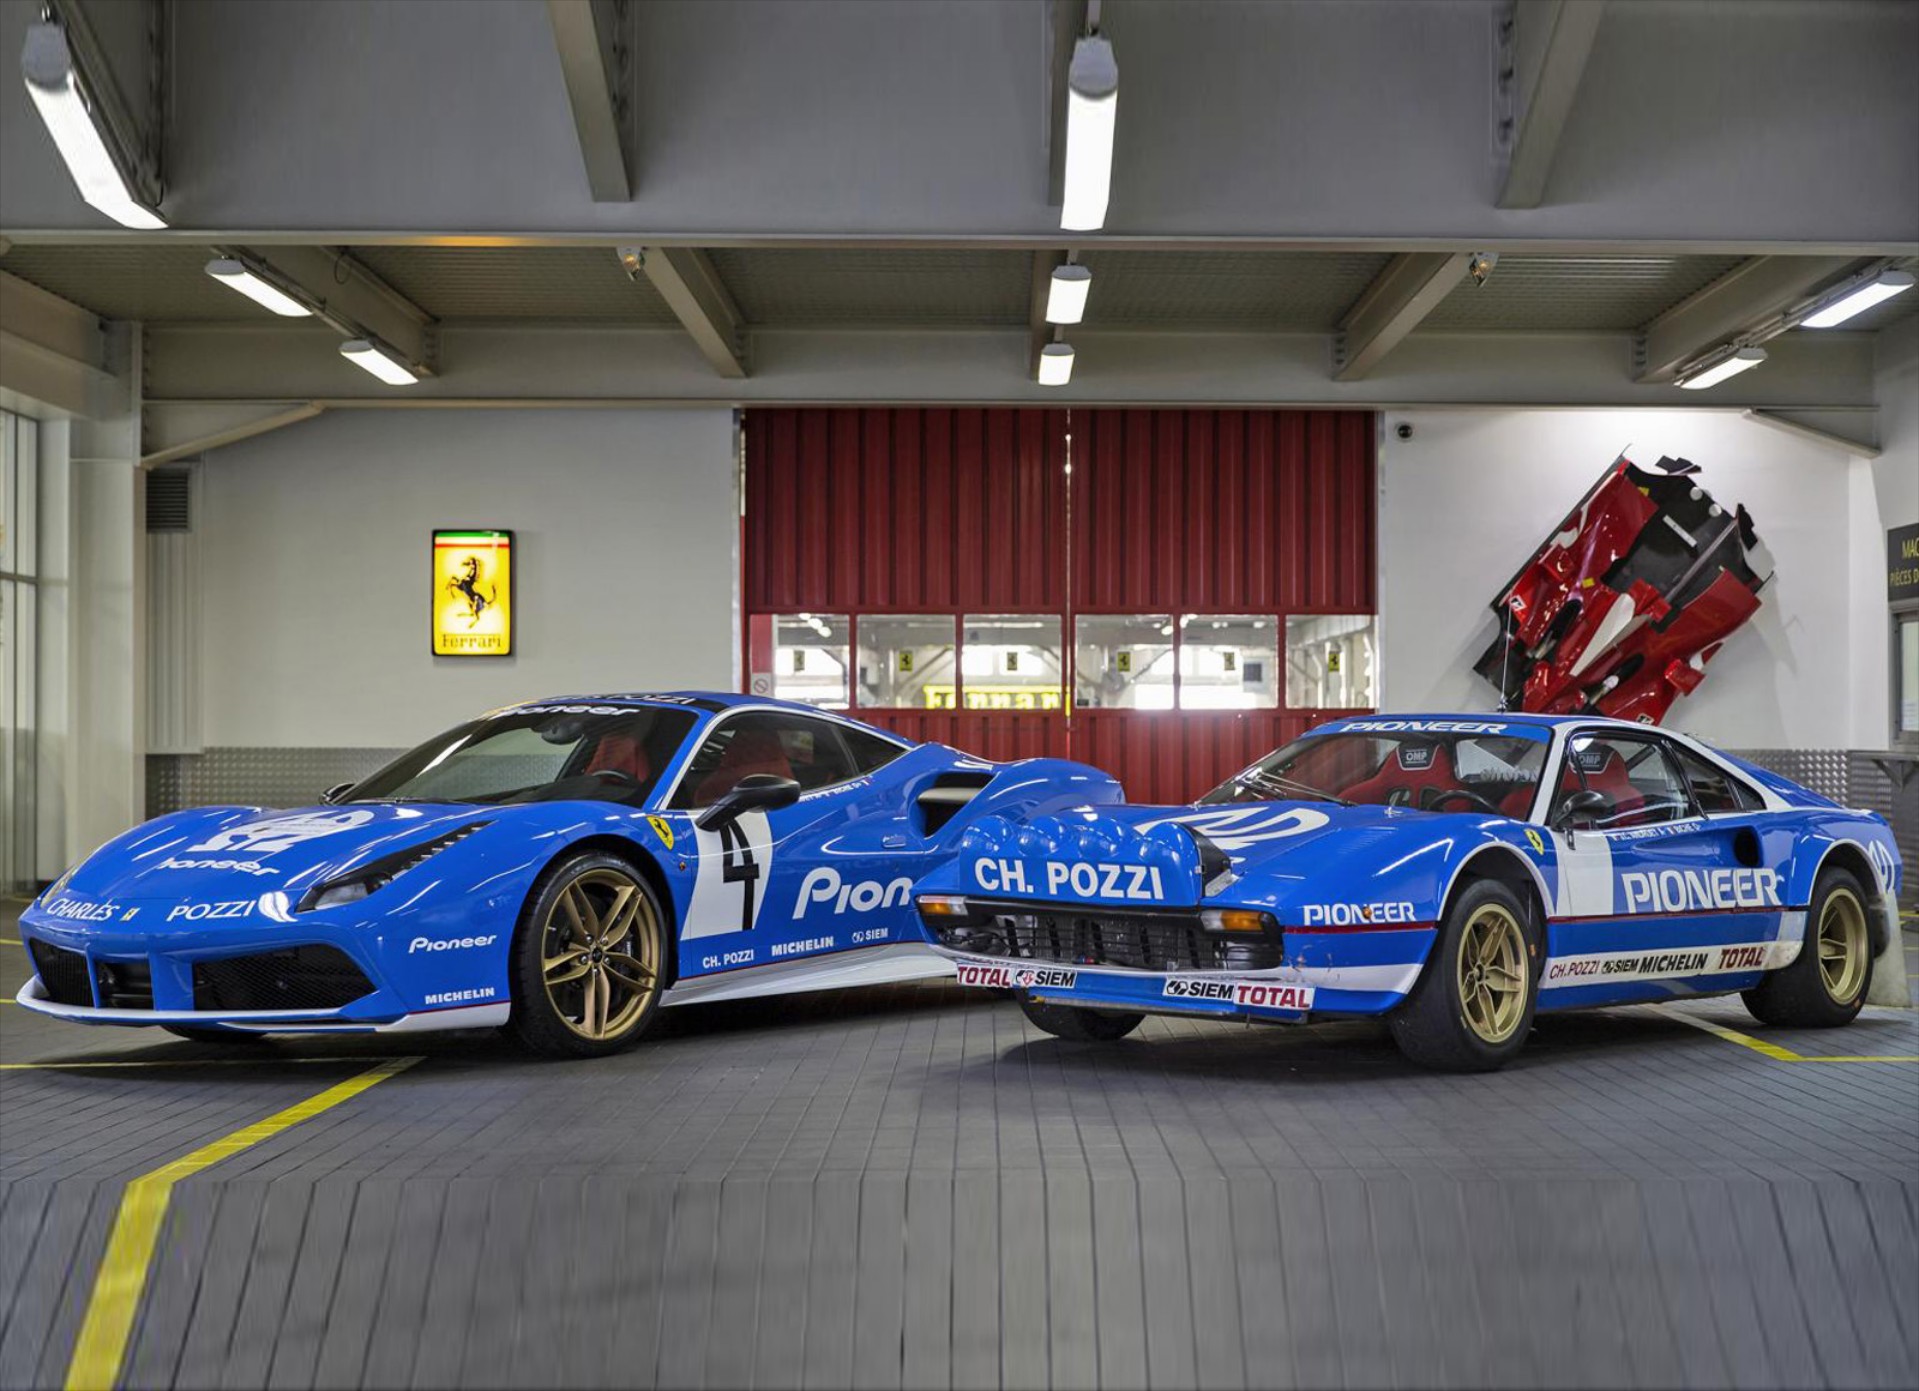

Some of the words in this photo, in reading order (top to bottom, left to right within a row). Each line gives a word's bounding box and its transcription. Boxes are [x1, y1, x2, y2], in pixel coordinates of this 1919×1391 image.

[442, 633, 501, 648] Ferrari
[1339, 721, 1508, 734] PIONEER
[1405, 751, 1428, 761] OMP
[975, 857, 1034, 893] CH.
[1047, 861, 1164, 900] POZZI
[792, 866, 914, 920] Pion
[1621, 867, 1783, 914] PIONEER
[46, 898, 120, 921] CHARLES
[166, 900, 256, 921] POZZI
[1303, 901, 1417, 926] PIONEER
[408, 935, 497, 954] Pioneer
[865, 928, 889, 941] SIEM
[771, 936, 834, 957] MICHELIN
[702, 955, 722, 969] CH.
[723, 950, 754, 966] POZZI
[1613, 958, 1638, 973] SIEM
[1639, 953, 1708, 974] MICHELIN
[1719, 947, 1767, 969] TOTAL
[957, 965, 1011, 988] TOTAL
[1034, 970, 1075, 988] SIEM
[424, 987, 495, 1005] MICHELIN
[1189, 982, 1234, 1000] SIEM
[1237, 985, 1312, 1009] TOTAL
